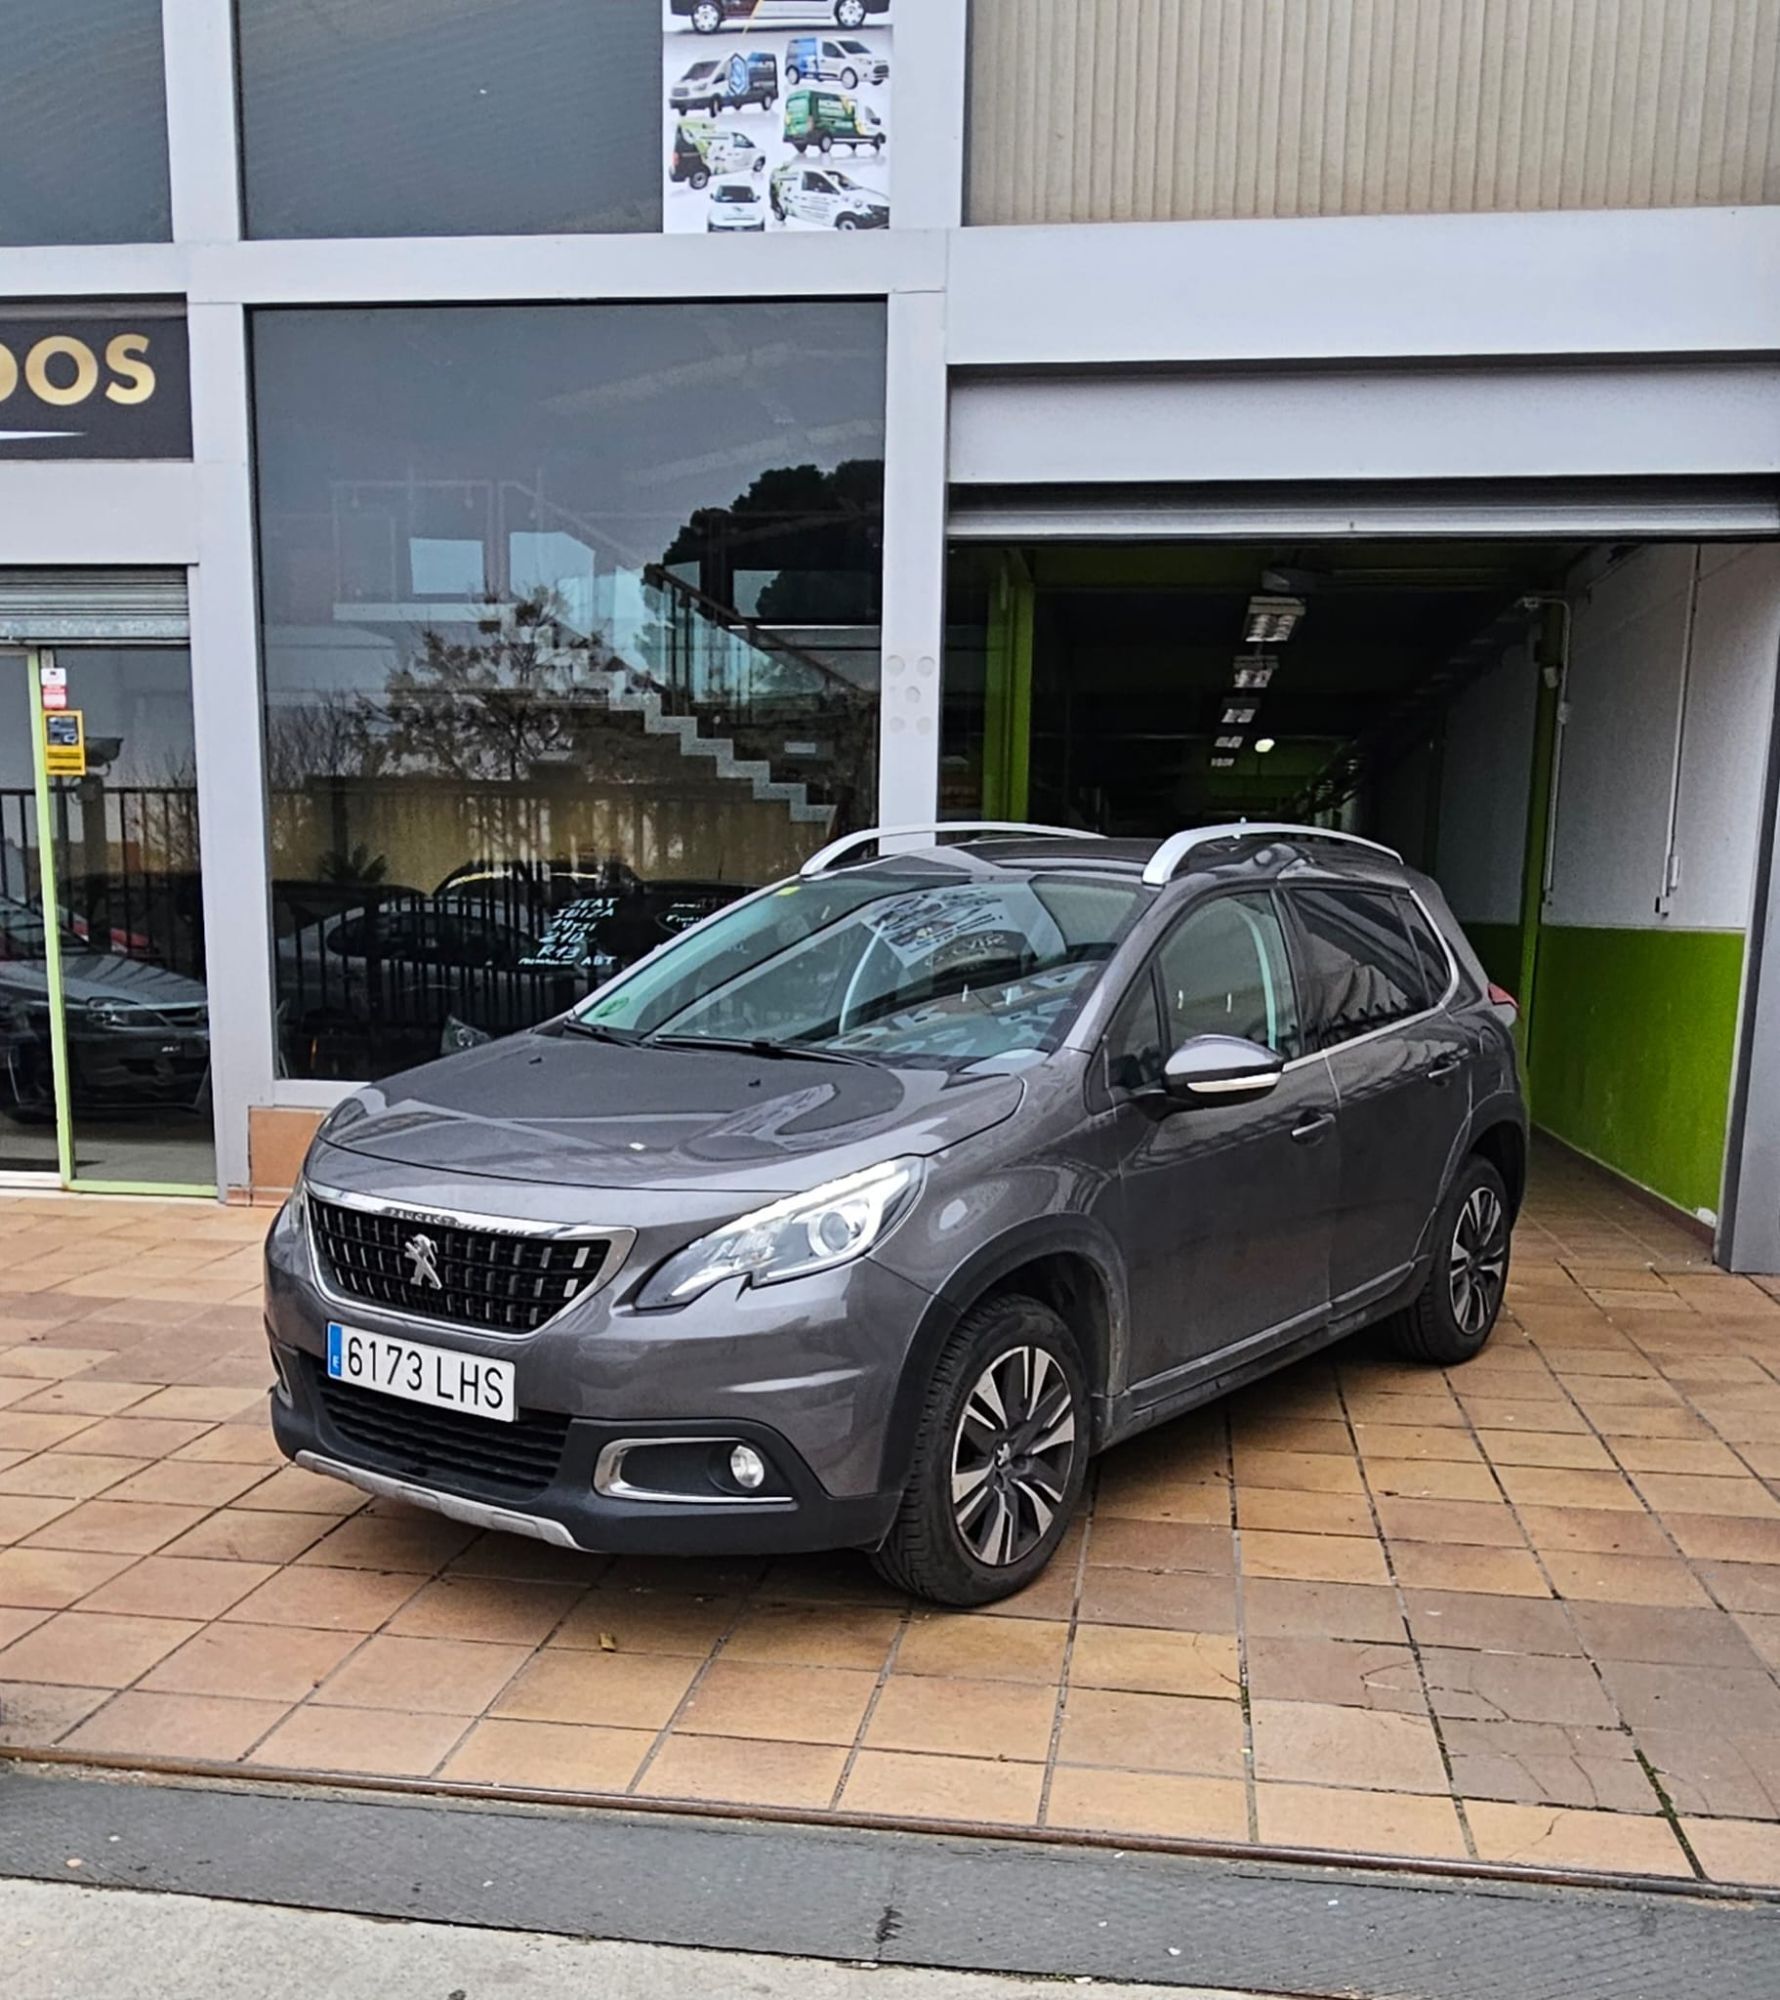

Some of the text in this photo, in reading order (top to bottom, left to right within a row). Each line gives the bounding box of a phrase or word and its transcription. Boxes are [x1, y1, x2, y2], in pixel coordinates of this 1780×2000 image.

[0, 333, 156, 406] OS
[347, 1336, 423, 1392] 6173
[436, 1355, 504, 1410] LHS
